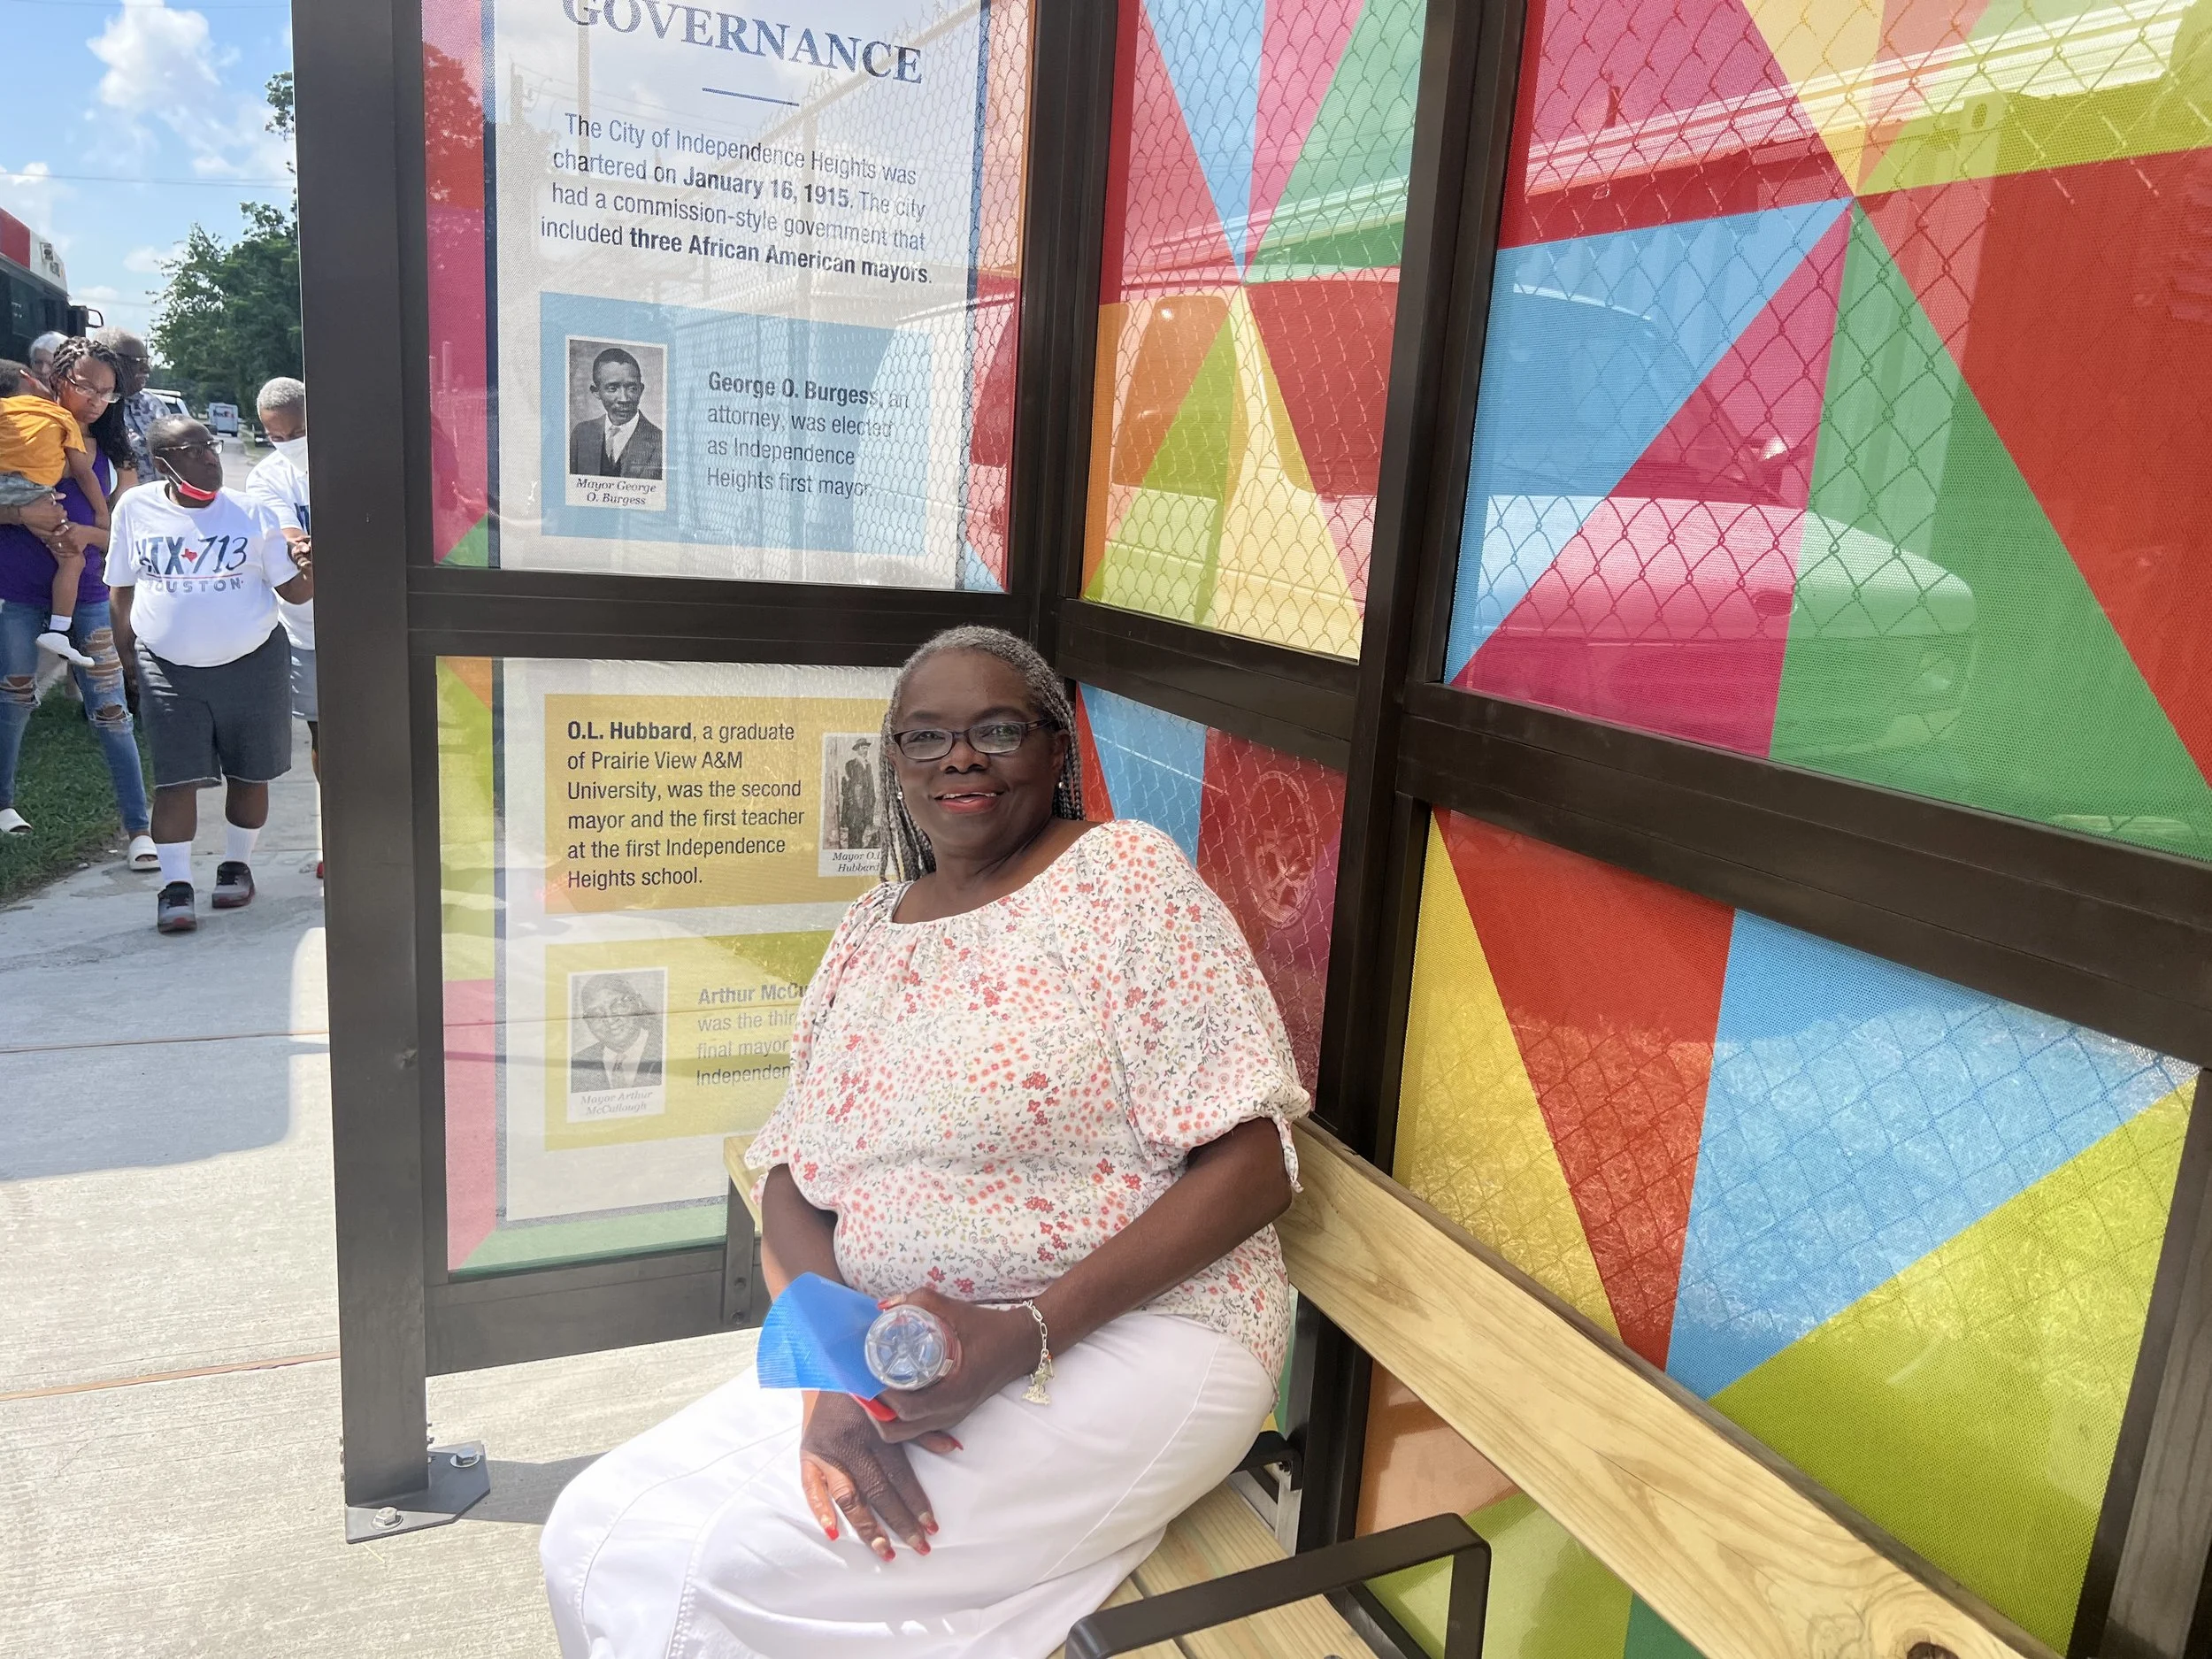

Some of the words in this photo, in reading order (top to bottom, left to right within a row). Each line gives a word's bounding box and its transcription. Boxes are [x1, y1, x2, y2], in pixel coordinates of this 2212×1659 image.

[562, 0, 923, 84] GOVERNANCE
[565, 112, 602, 139] The
[609, 119, 644, 149] City
[652, 127, 671, 149] of
[676, 130, 805, 168] Independence
[812, 150, 876, 182] Heights
[883, 166, 917, 186] was
[553, 148, 647, 180] chartered
[654, 165, 677, 184] on
[683, 167, 764, 201] January
[770, 178, 798, 204] 16,
[804, 184, 854, 210] 1915.
[858, 190, 890, 214] The
[895, 197, 926, 223] city
[552, 182, 588, 207] had
[595, 192, 607, 210] a
[613, 194, 778, 233] commission-style
[784, 218, 888, 246] government
[893, 228, 926, 251] that
[541, 217, 623, 247] included
[630, 229, 682, 253] three
[688, 235, 759, 264] African
[765, 245, 856, 274] American
[861, 261, 933, 285] mayors.
[709, 371, 776, 398] George
[781, 378, 799, 398] O.
[708, 405, 786, 432] attorney,
[791, 415, 826, 433] was
[831, 417, 892, 438] elected
[708, 441, 727, 456] as
[733, 438, 856, 465] Independence
[576, 478, 614, 492] Mayor
[617, 480, 657, 495] George
[707, 467, 774, 495] Heights
[779, 472, 813, 494] first
[587, 492, 598, 502] O.
[603, 493, 646, 507] Burgess
[567, 721, 604, 741] O.L.
[610, 721, 697, 742] Hubbard,
[703, 726, 713, 740] a
[718, 723, 795, 743] graduate
[567, 750, 586, 770] of
[592, 749, 649, 770] Prairie
[654, 750, 696, 769] View
[701, 751, 743, 769] A&M
[567, 780, 662, 803] University,
[667, 785, 703, 798] was
[709, 780, 736, 797] the
[741, 780, 802, 797] second
[567, 813, 626, 834] mayor
[631, 810, 664, 828] and
[670, 809, 697, 827] the
[703, 808, 737, 826] first
[741, 807, 805, 826] teacher
[567, 842, 587, 860] at
[591, 841, 619, 858] the
[625, 839, 660, 857] first
[666, 837, 786, 859] Independence
[833, 852, 864, 862] Mayor
[567, 869, 635, 891] Heights
[641, 867, 703, 886] school.
[698, 987, 756, 1005] Arthur
[697, 1018, 732, 1032] was
[737, 1012, 762, 1029] the
[768, 1010, 796, 1026] thir
[696, 1041, 732, 1059] final
[738, 1040, 789, 1057] mayor
[696, 1064, 792, 1087] Independen
[580, 1095, 616, 1106] Mayor
[618, 1091, 653, 1101] Arthur
